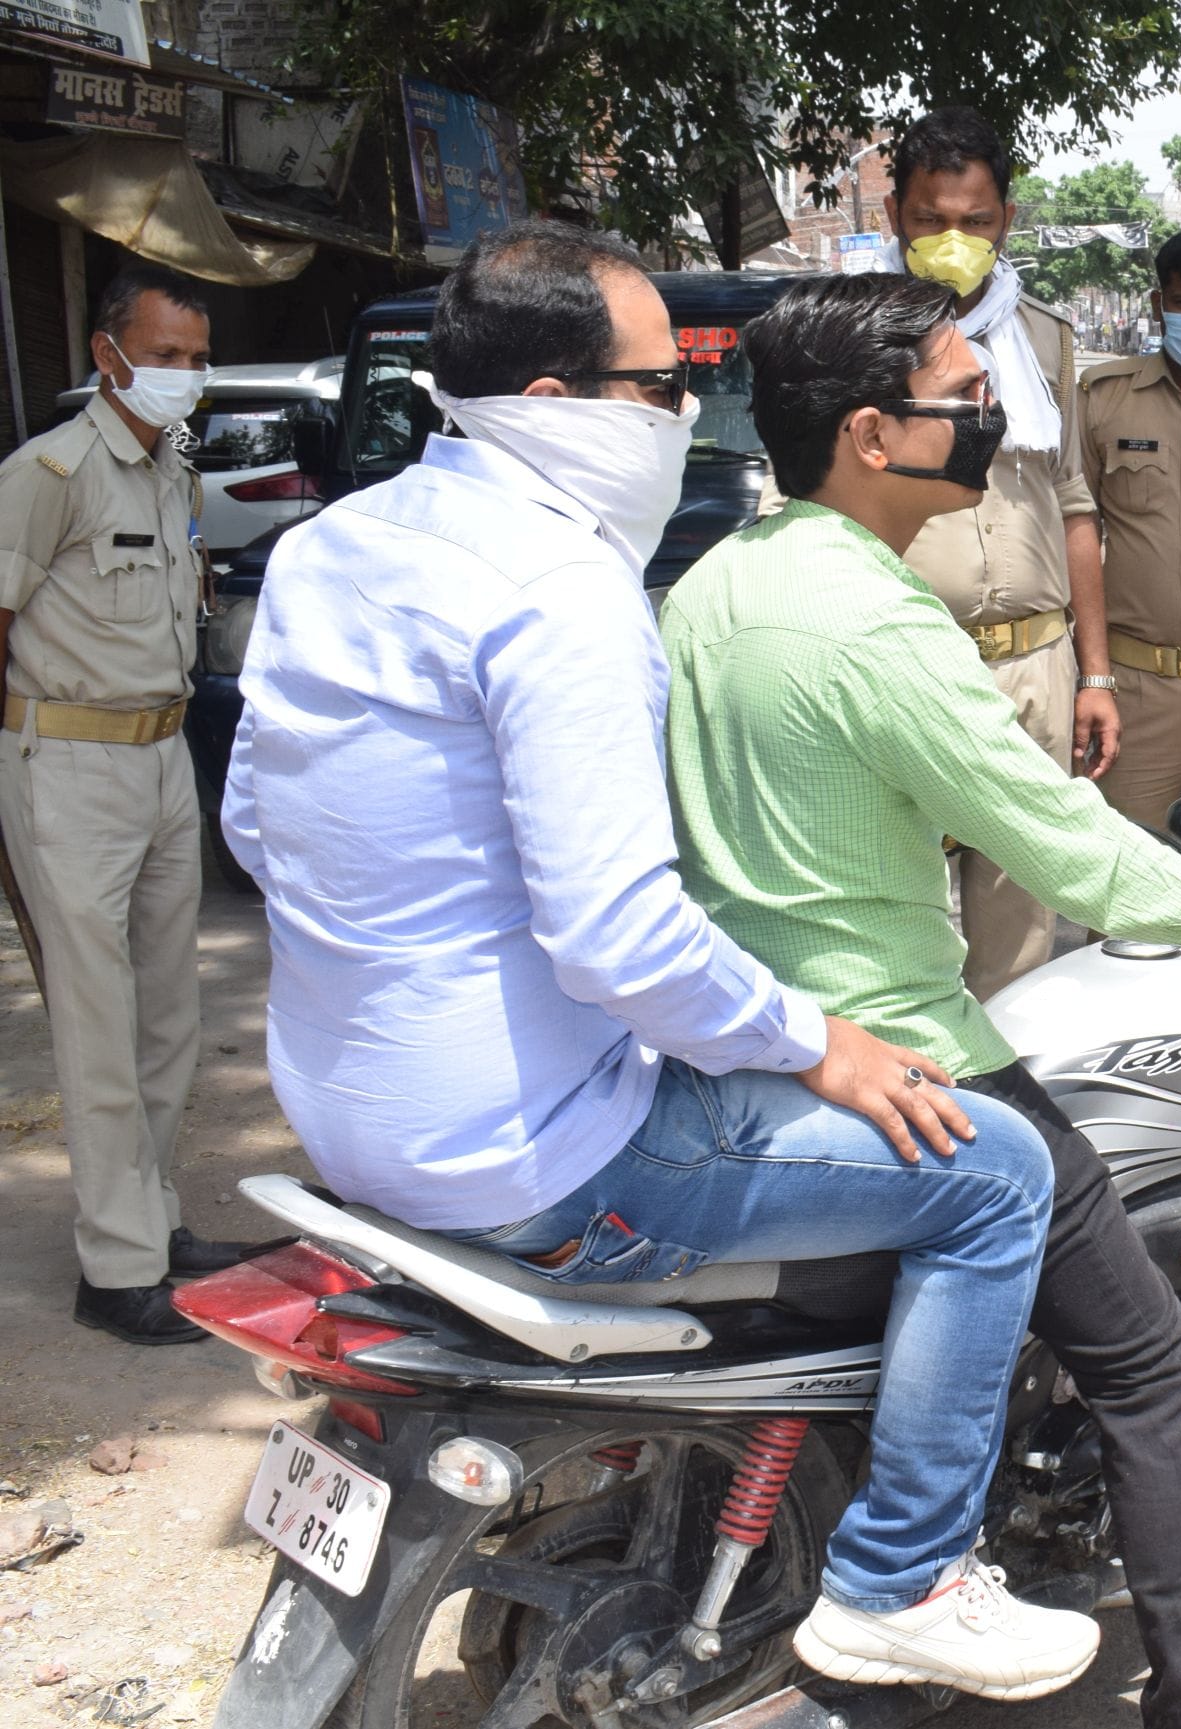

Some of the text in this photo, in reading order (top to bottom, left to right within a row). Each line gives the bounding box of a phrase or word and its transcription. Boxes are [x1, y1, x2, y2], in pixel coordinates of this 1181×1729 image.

[53, 68, 185, 118] मानस ट्रेडर्स
[370, 331, 427, 341] POLICE
[232, 413, 281, 421] POLICE
[288, 1447, 350, 1515] UP 30
[266, 1488, 348, 1574] Z 8746
